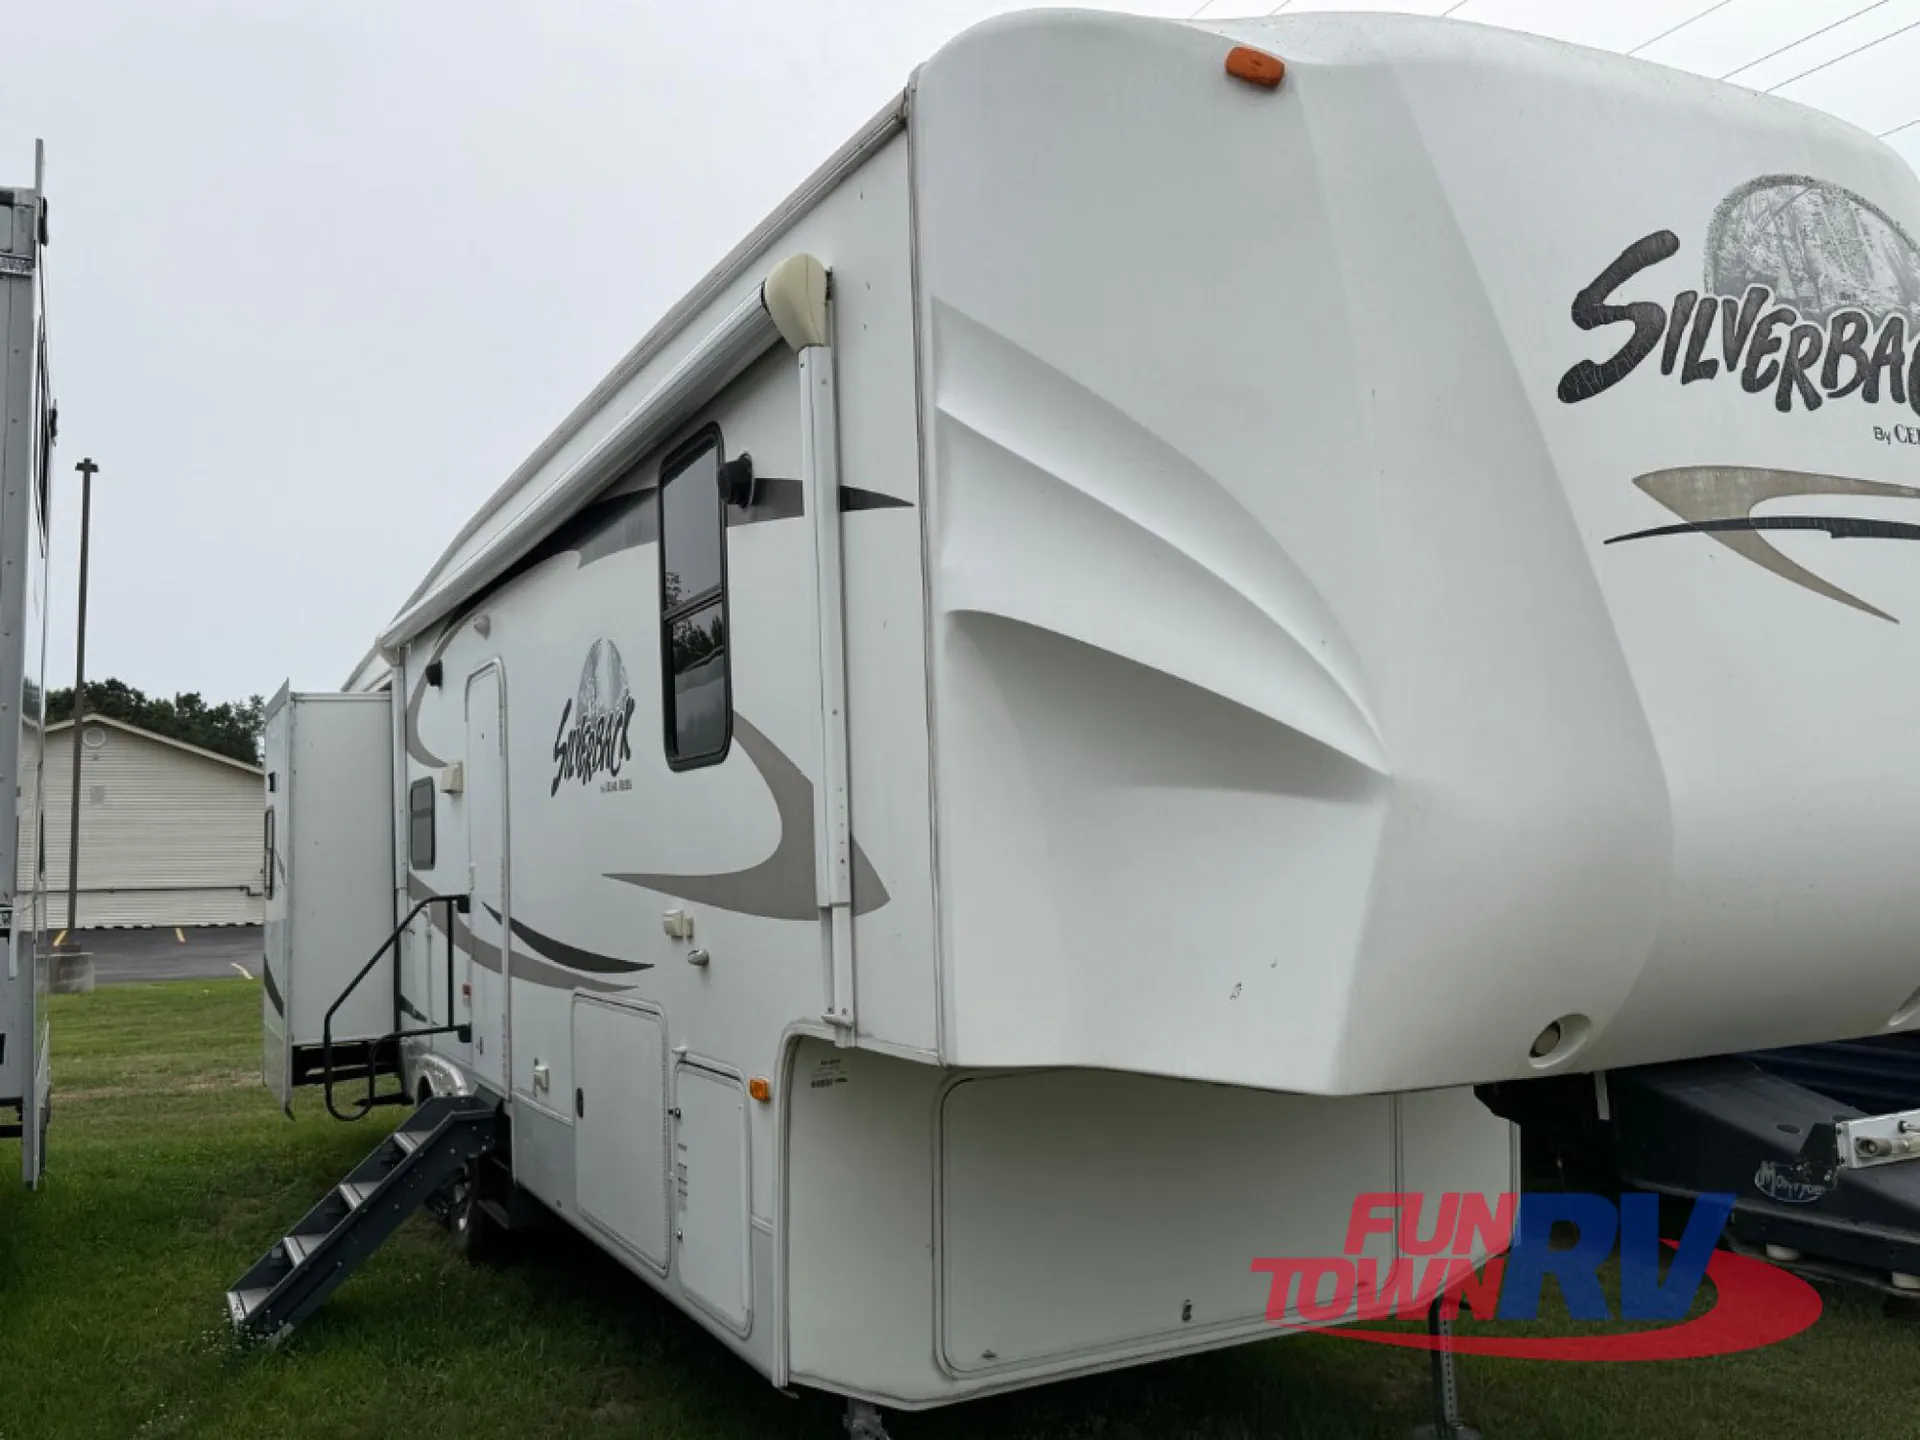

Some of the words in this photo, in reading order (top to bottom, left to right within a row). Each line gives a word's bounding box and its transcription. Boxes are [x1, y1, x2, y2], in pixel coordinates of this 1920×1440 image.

[1557, 229, 1920, 417] SILVERBA
[1874, 425, 1891, 445] By
[1894, 423, 1920, 445] CE
